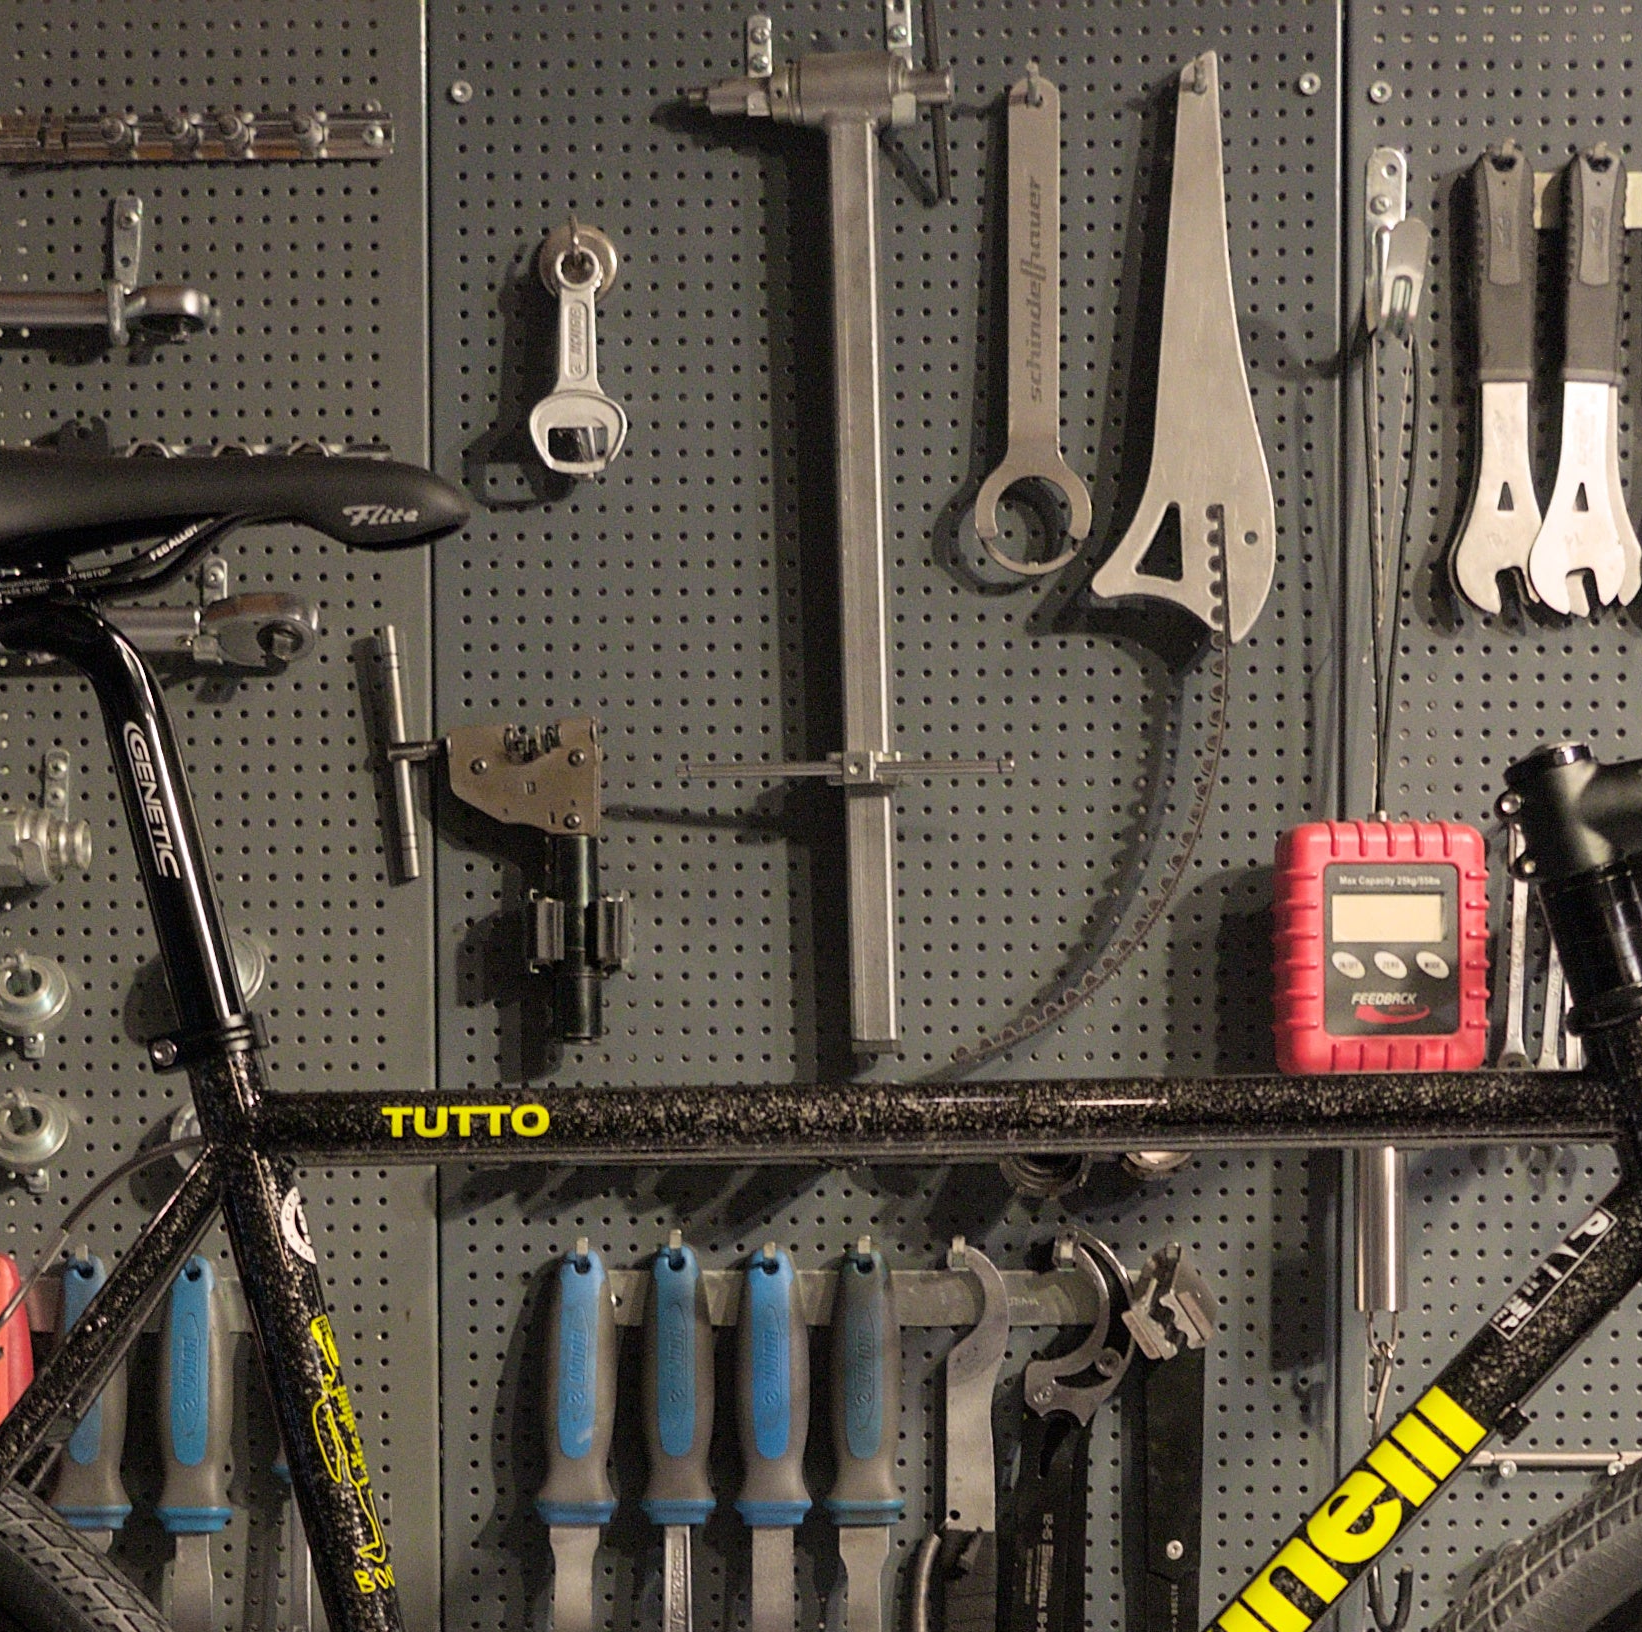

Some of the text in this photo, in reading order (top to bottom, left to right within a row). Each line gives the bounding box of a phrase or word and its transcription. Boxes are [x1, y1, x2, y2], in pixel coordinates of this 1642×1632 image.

[126, 726, 180, 879] GENETIC
[1350, 992, 1417, 1006] FEEDBACK
[381, 1104, 551, 1138] TUTTO
